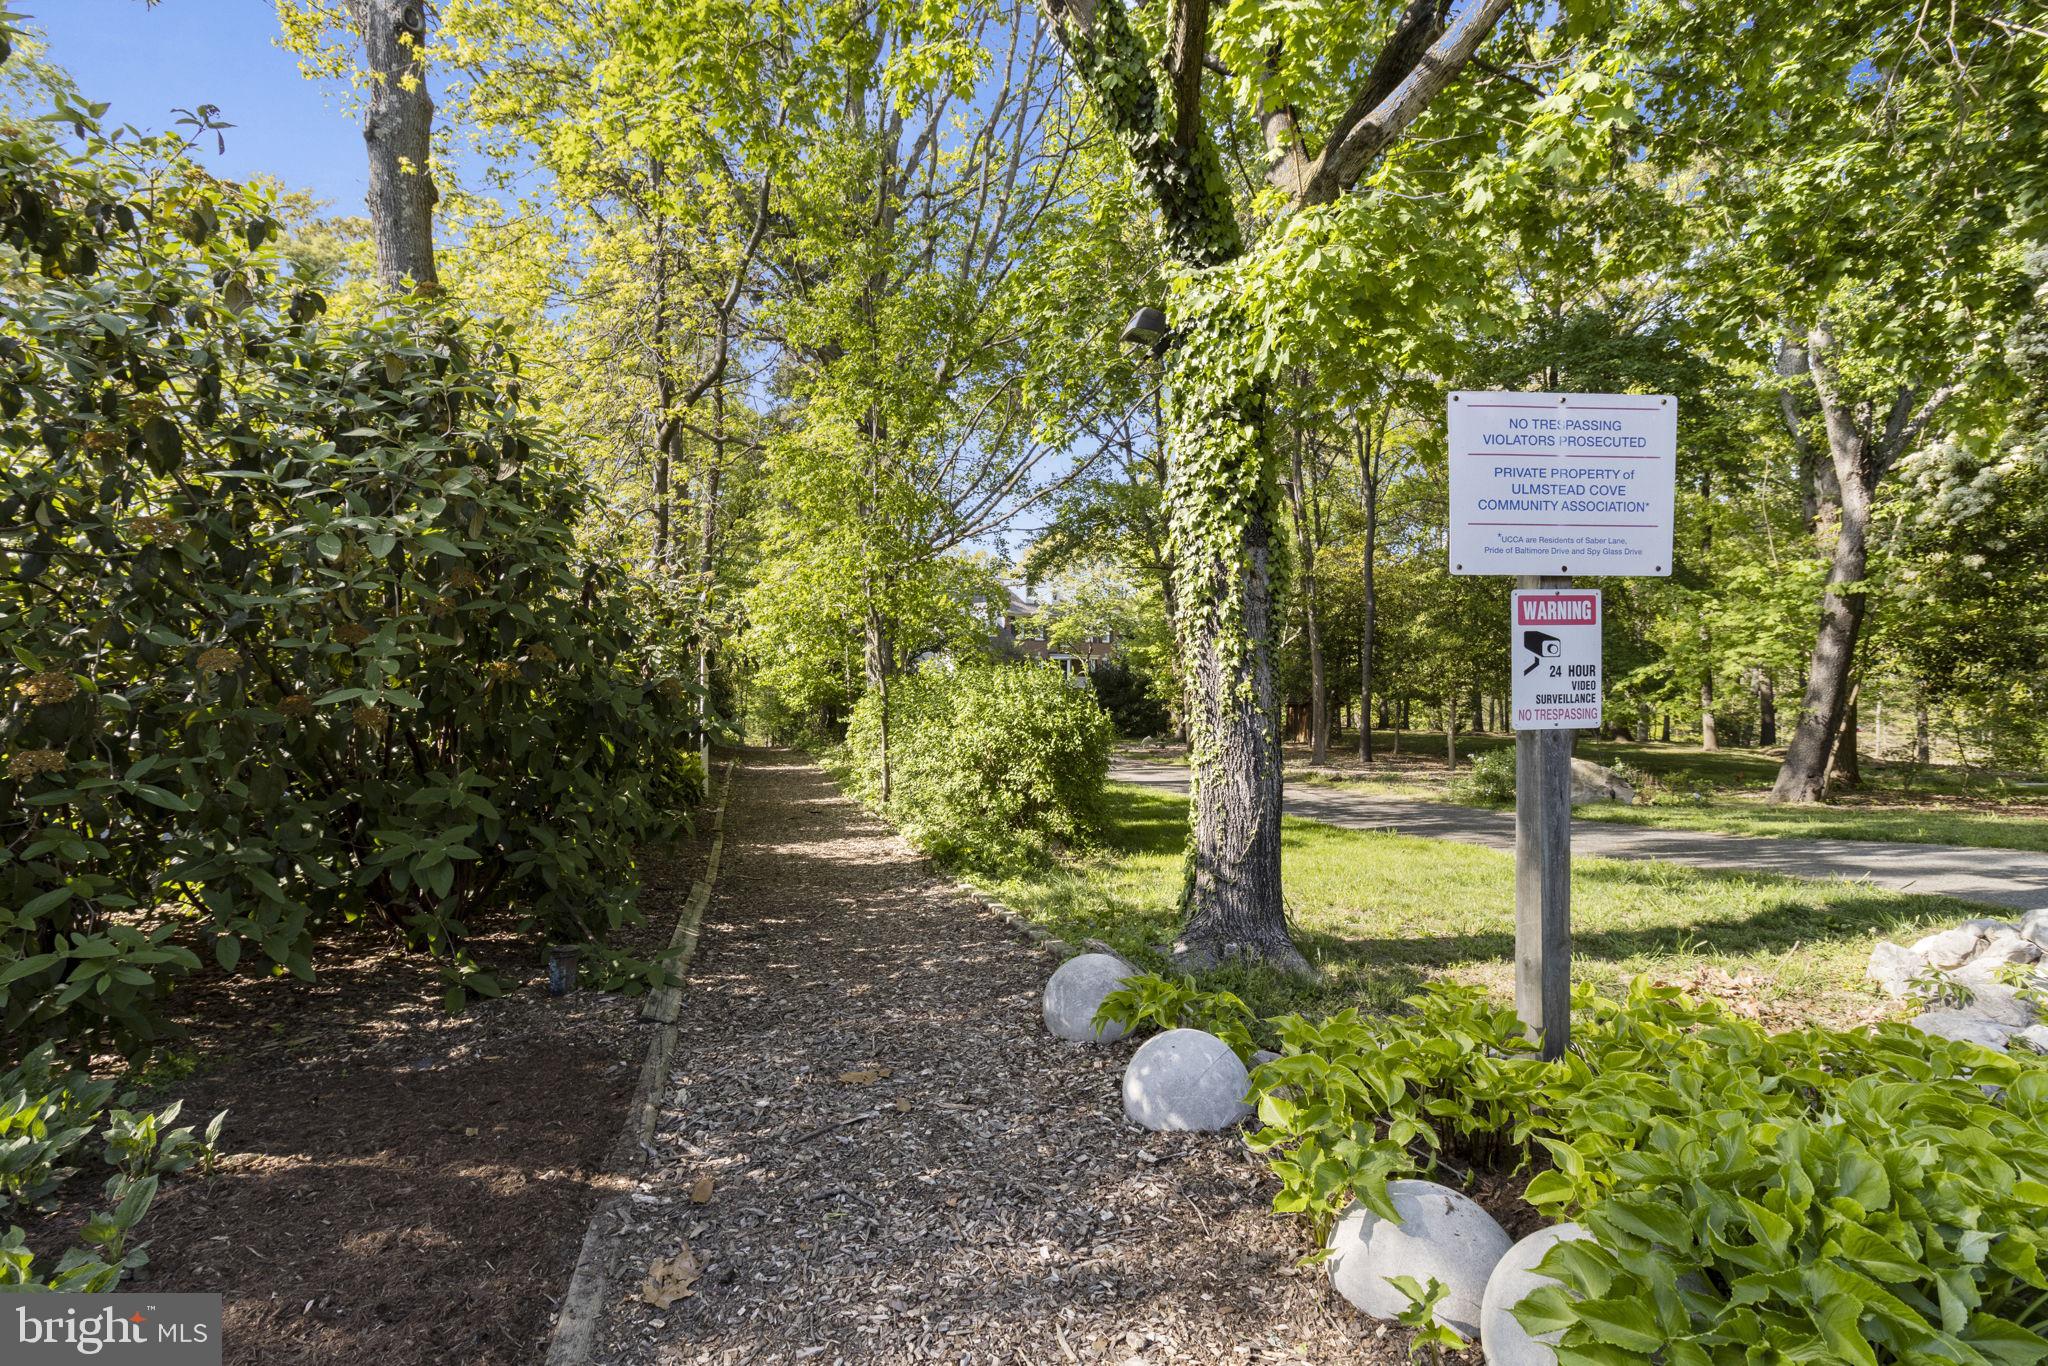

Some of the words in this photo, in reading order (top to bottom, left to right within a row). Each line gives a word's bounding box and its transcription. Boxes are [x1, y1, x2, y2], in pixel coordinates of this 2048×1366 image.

[1509, 418, 1528, 429] NO
[1483, 434, 1555, 446] VIOLATORS
[1559, 436, 1647, 448] PROSECUTED
[1495, 468, 1546, 478] PRIVATE
[1551, 469, 1620, 479] PROPERTY
[1623, 470, 1635, 479] of
[1511, 484, 1585, 495] ULMSTEAD
[1589, 485, 1626, 496] COVE
[1478, 499, 1558, 511] COMMUNITY
[1539, 536, 1572, 544] Residents
[1515, 547, 1549, 555] Baltimore
[1551, 547, 1571, 555] Drive
[1587, 548, 1601, 557] Spy
[1523, 600, 1592, 620] WARNING
[1550, 666, 1562, 677] 24
[1568, 665, 1596, 677] HOUR
[1572, 681, 1596, 690] VIDEO
[1536, 693, 1596, 704] SURVEILLANCE
[1518, 709, 1531, 720] NO
[1535, 708, 1598, 720] TRESPASSING
